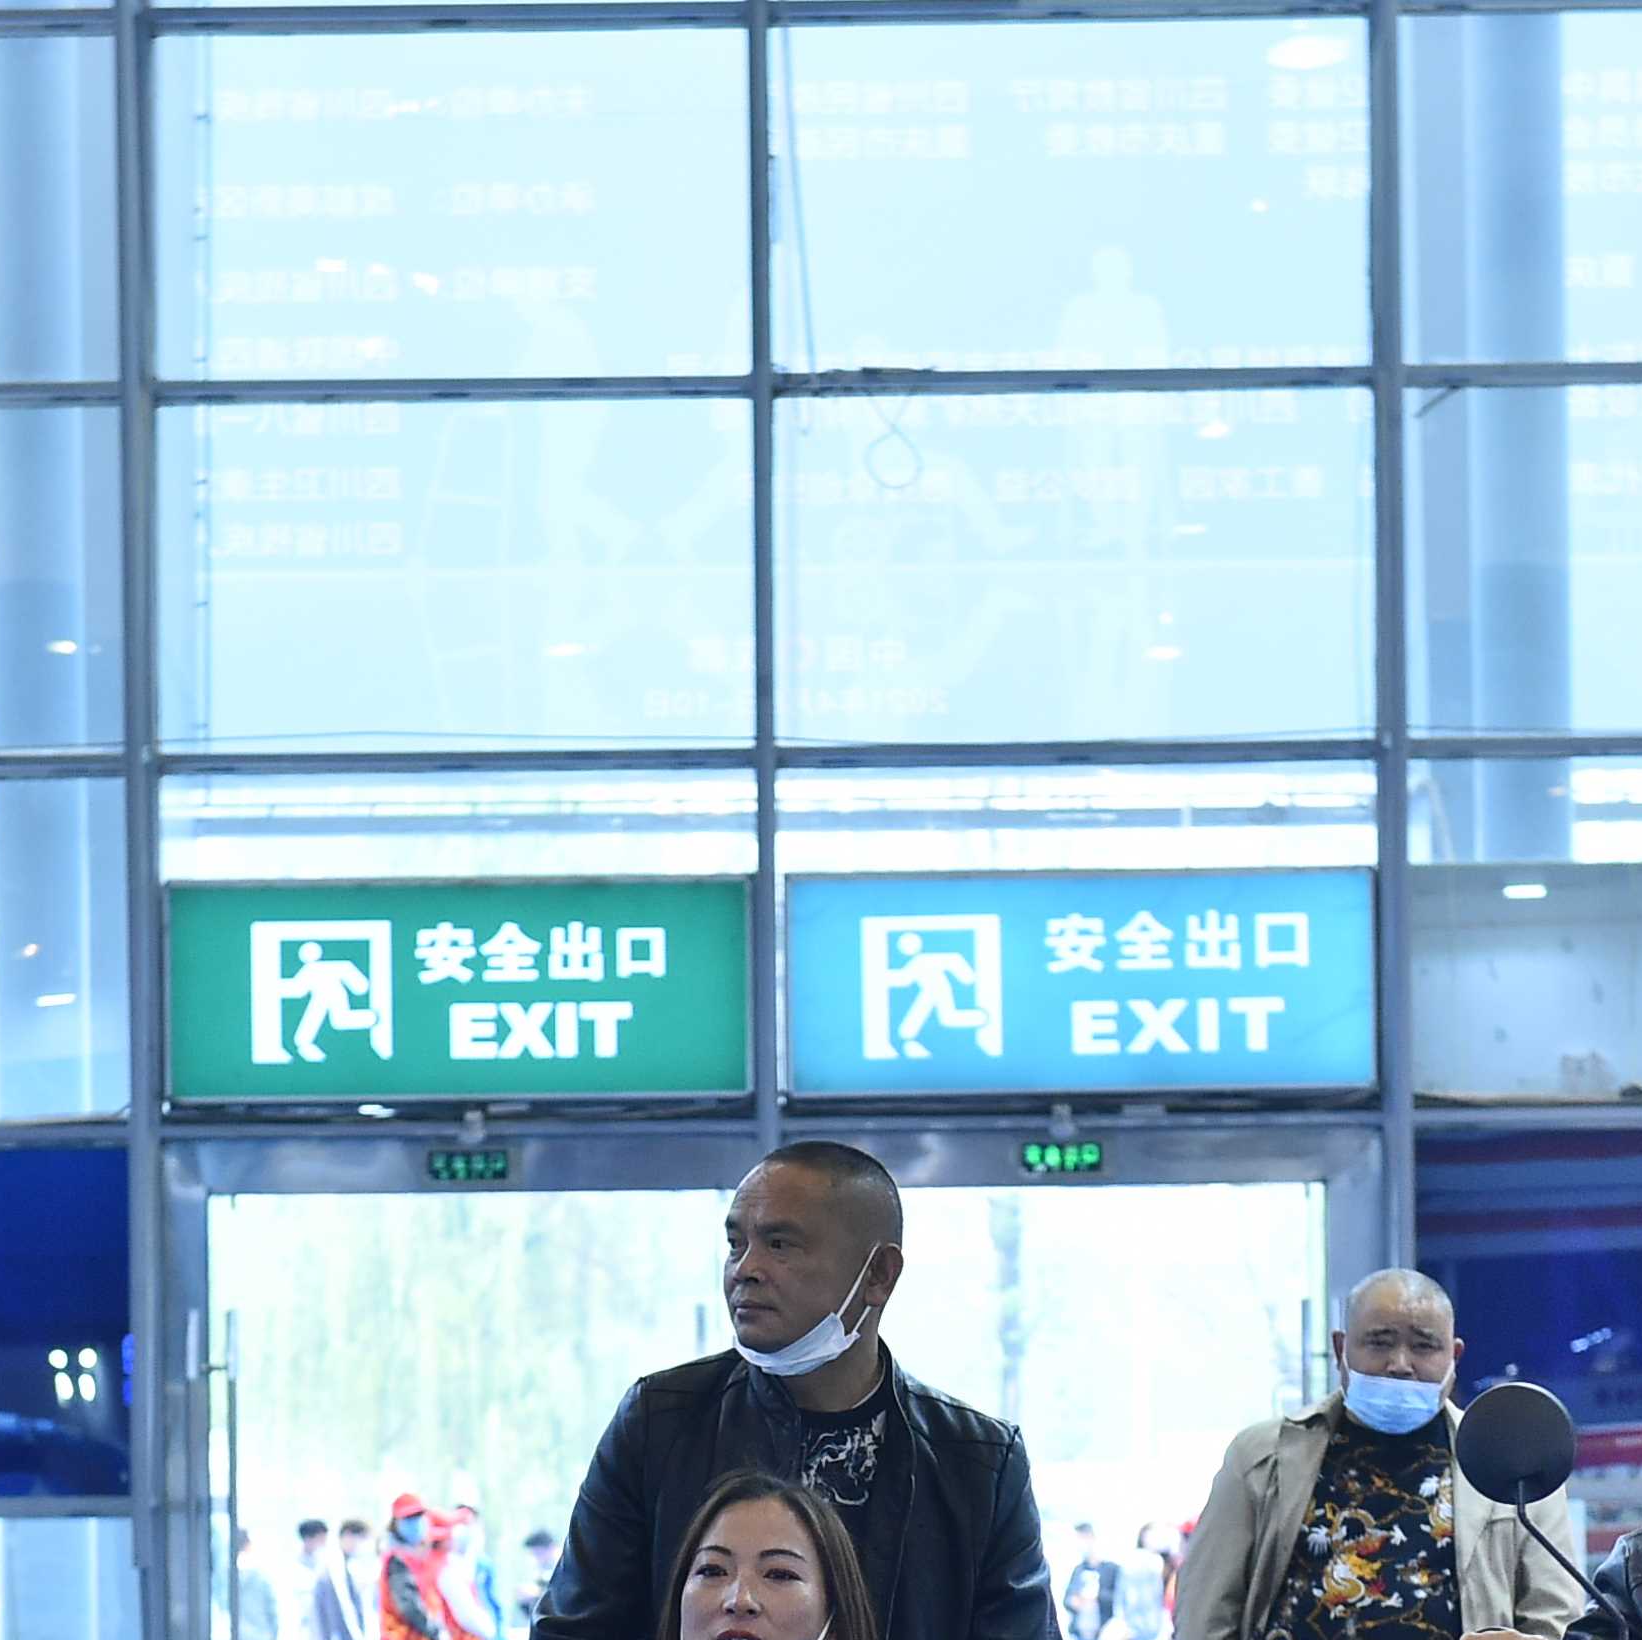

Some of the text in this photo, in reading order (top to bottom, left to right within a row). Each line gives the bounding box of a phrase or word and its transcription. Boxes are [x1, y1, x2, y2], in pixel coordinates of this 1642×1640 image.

[414, 920, 666, 983] 安全出口
[1044, 910, 1311, 973] 安全出口
[449, 1002, 634, 1059] EXIT
[1071, 996, 1285, 1055] EXIT
